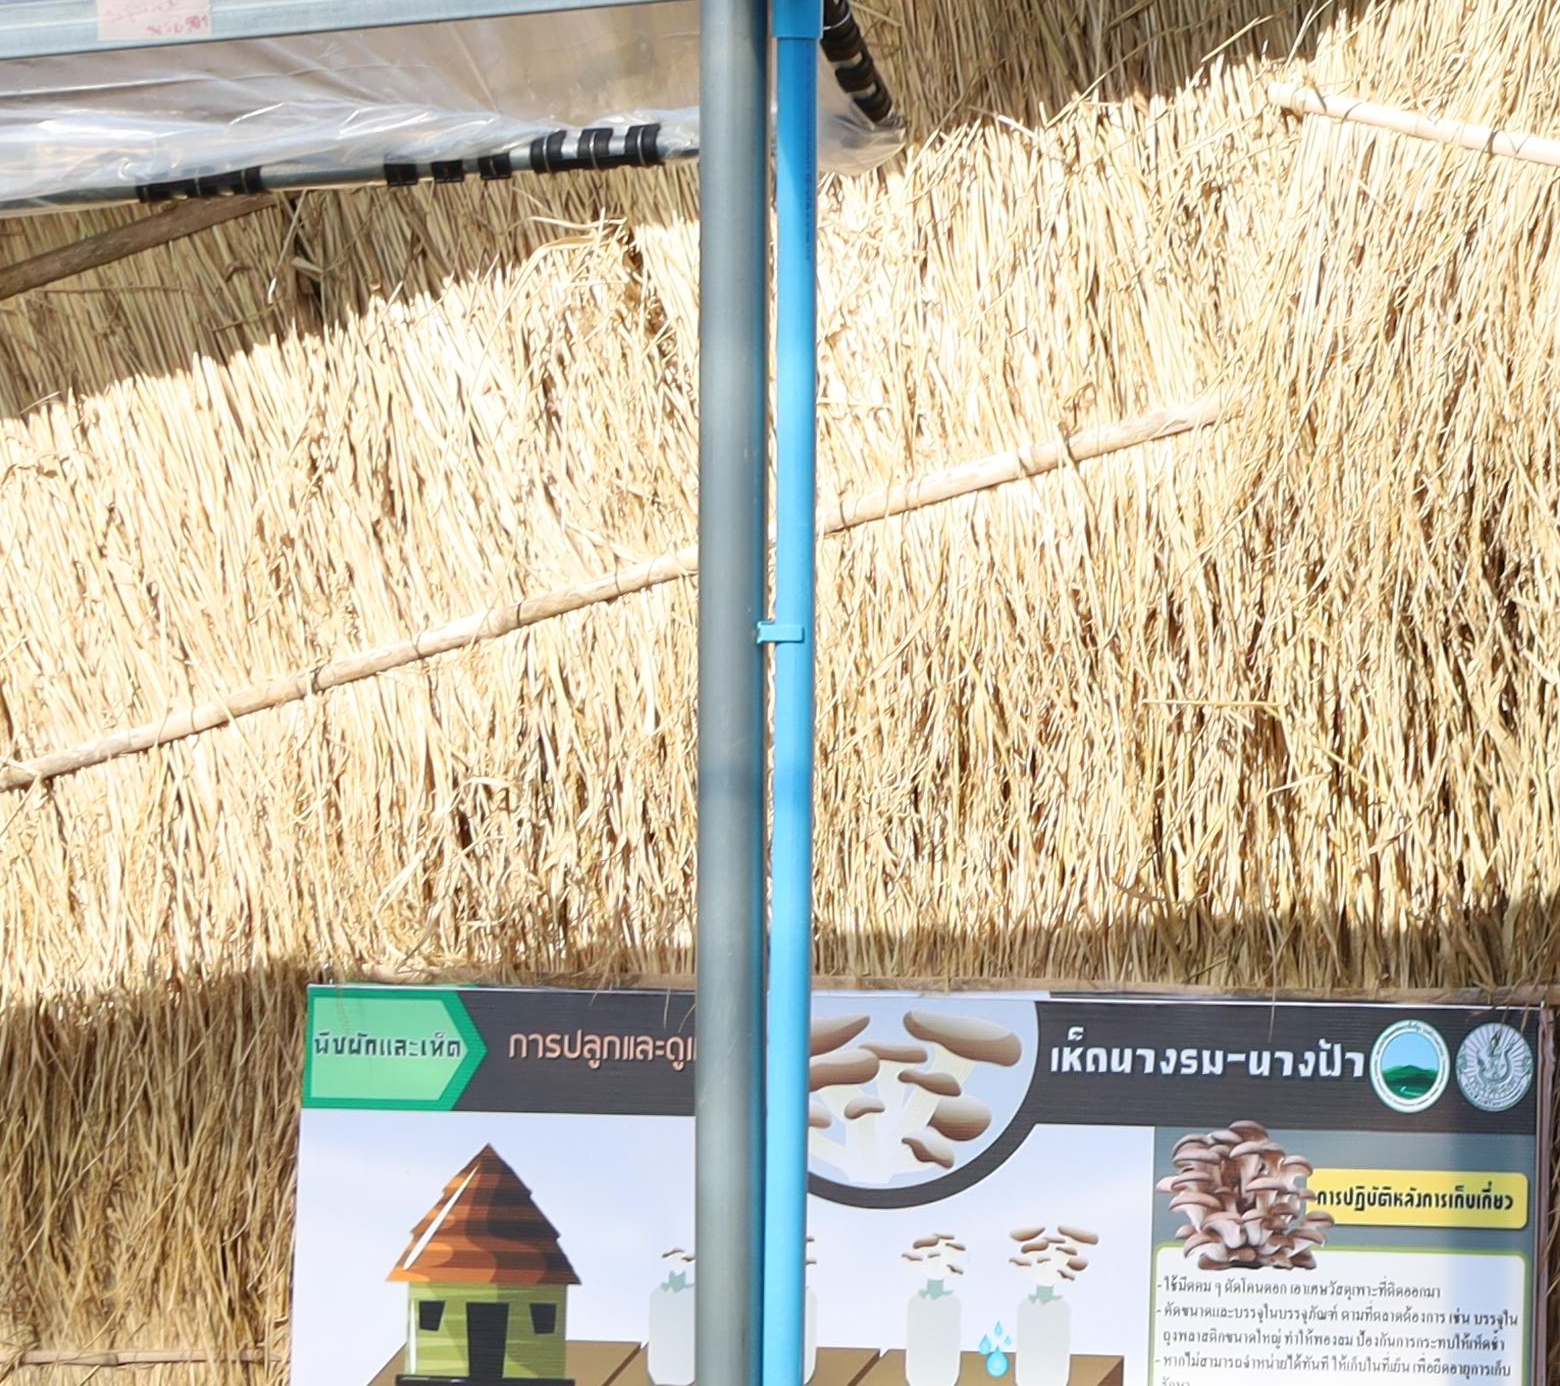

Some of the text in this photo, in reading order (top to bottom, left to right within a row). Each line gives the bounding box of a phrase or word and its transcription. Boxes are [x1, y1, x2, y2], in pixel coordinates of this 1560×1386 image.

[314, 1031, 461, 1057] พืชผักและเห็ด
[508, 1029, 696, 1071] การปลูกและดูแ
[1050, 1026, 1365, 1077] เห็ดนางรม-นางฟ้า
[1315, 1182, 1513, 1211] การปฏิบัติหลังการเก็บเกี่ยว
